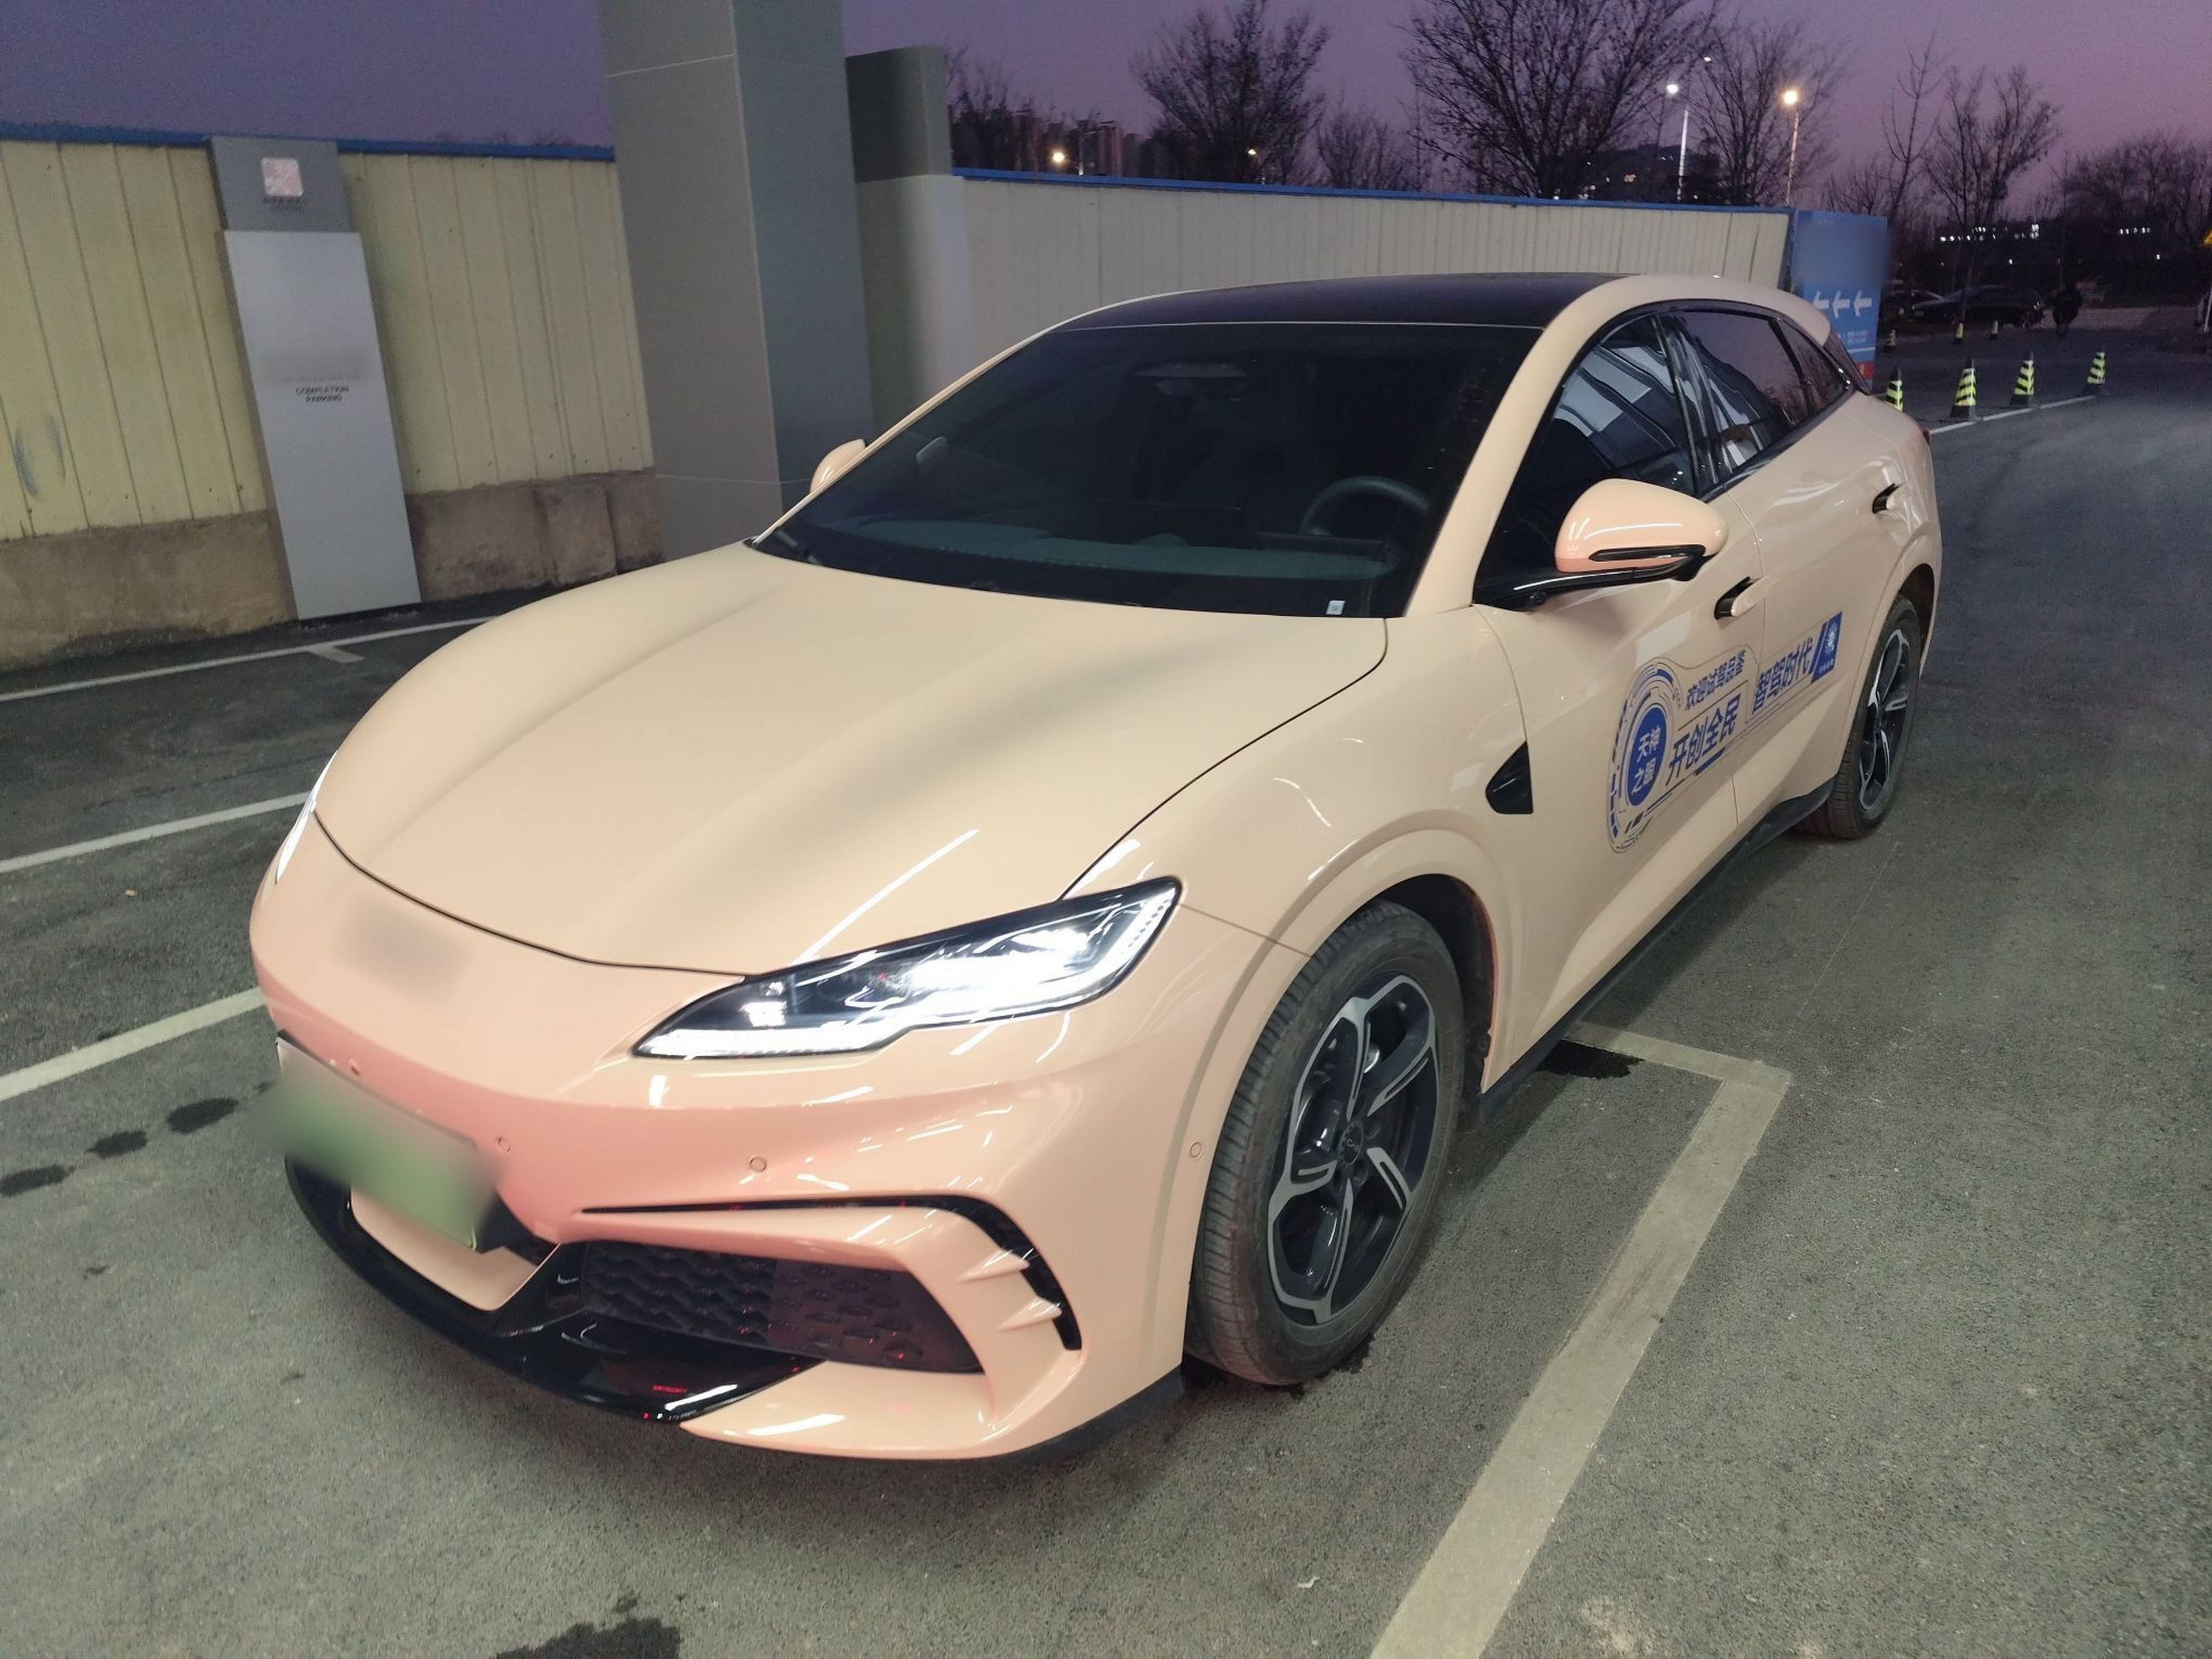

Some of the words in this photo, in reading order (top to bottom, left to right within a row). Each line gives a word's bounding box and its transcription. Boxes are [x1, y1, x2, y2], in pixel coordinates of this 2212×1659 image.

[1665, 693, 1741, 786] 开创全民
[1752, 637, 1813, 715] 智驾时代
[1637, 724, 1661, 763] 天神
[1631, 757, 1656, 795] 之眼
